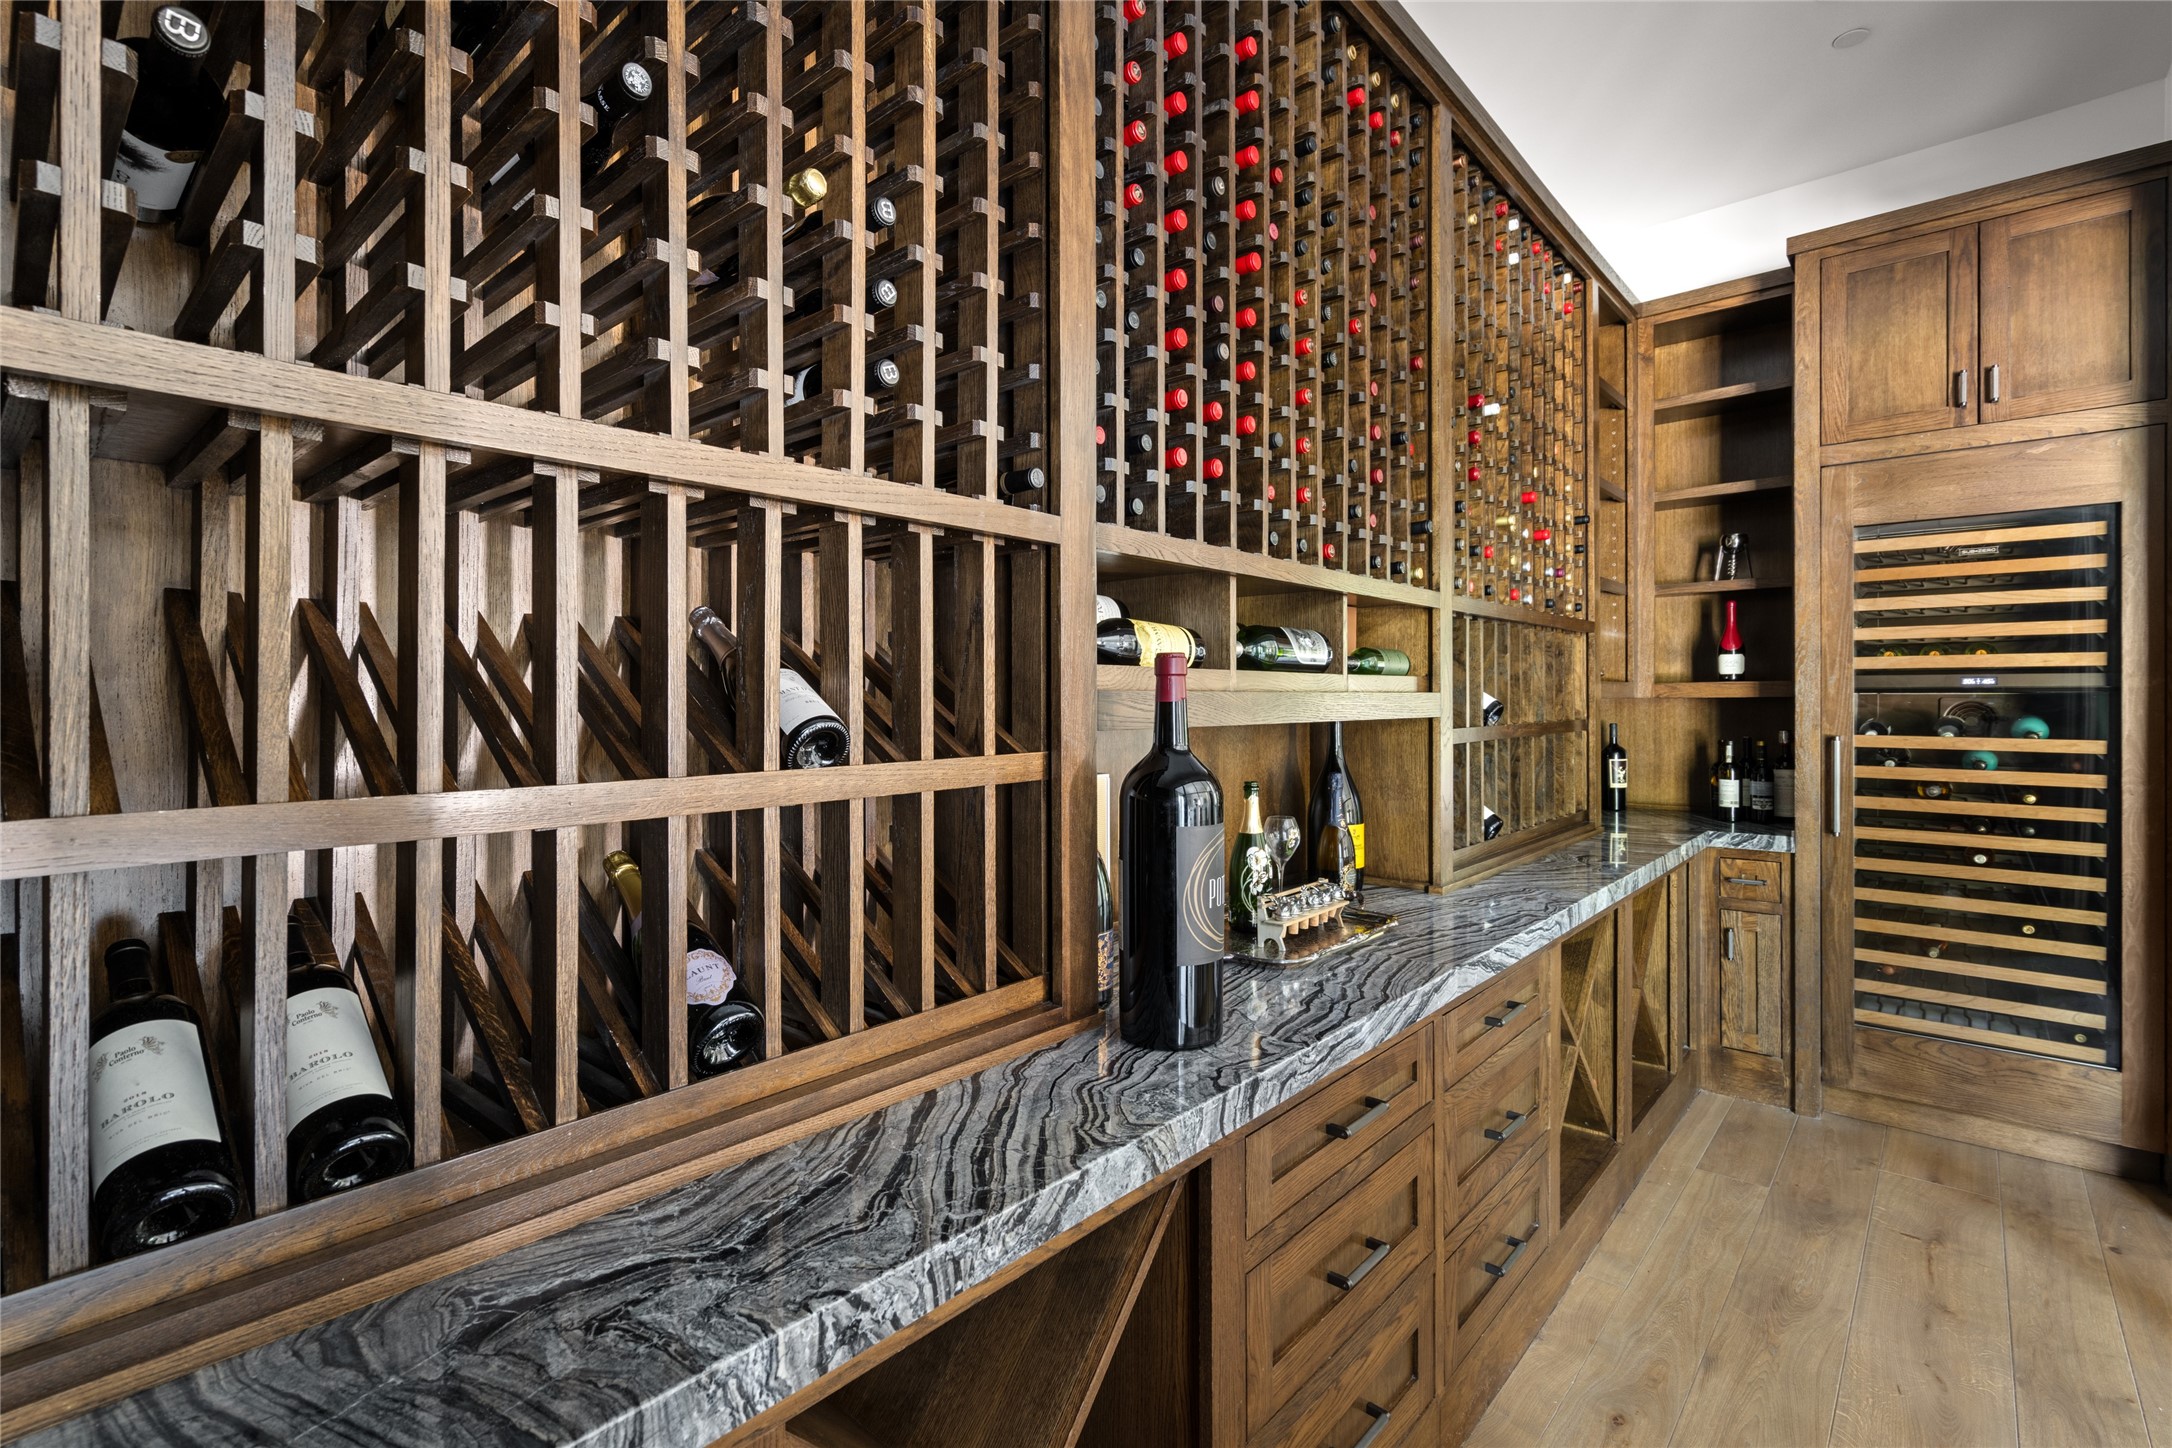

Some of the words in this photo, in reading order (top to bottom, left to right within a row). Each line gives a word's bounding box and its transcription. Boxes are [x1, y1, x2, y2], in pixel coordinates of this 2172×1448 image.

[165, 8, 201, 42] B
[880, 201, 894, 219] B
[881, 283, 898, 301] B
[882, 364, 898, 380] B
[291, 1011, 323, 1027] Conterno
[296, 1009, 316, 1020] Paolo
[108, 1048, 145, 1067] Conterno
[114, 1046, 137, 1059] Paolo
[288, 1051, 354, 1081] BAROLO
[101, 1092, 175, 1129] BAROLO
